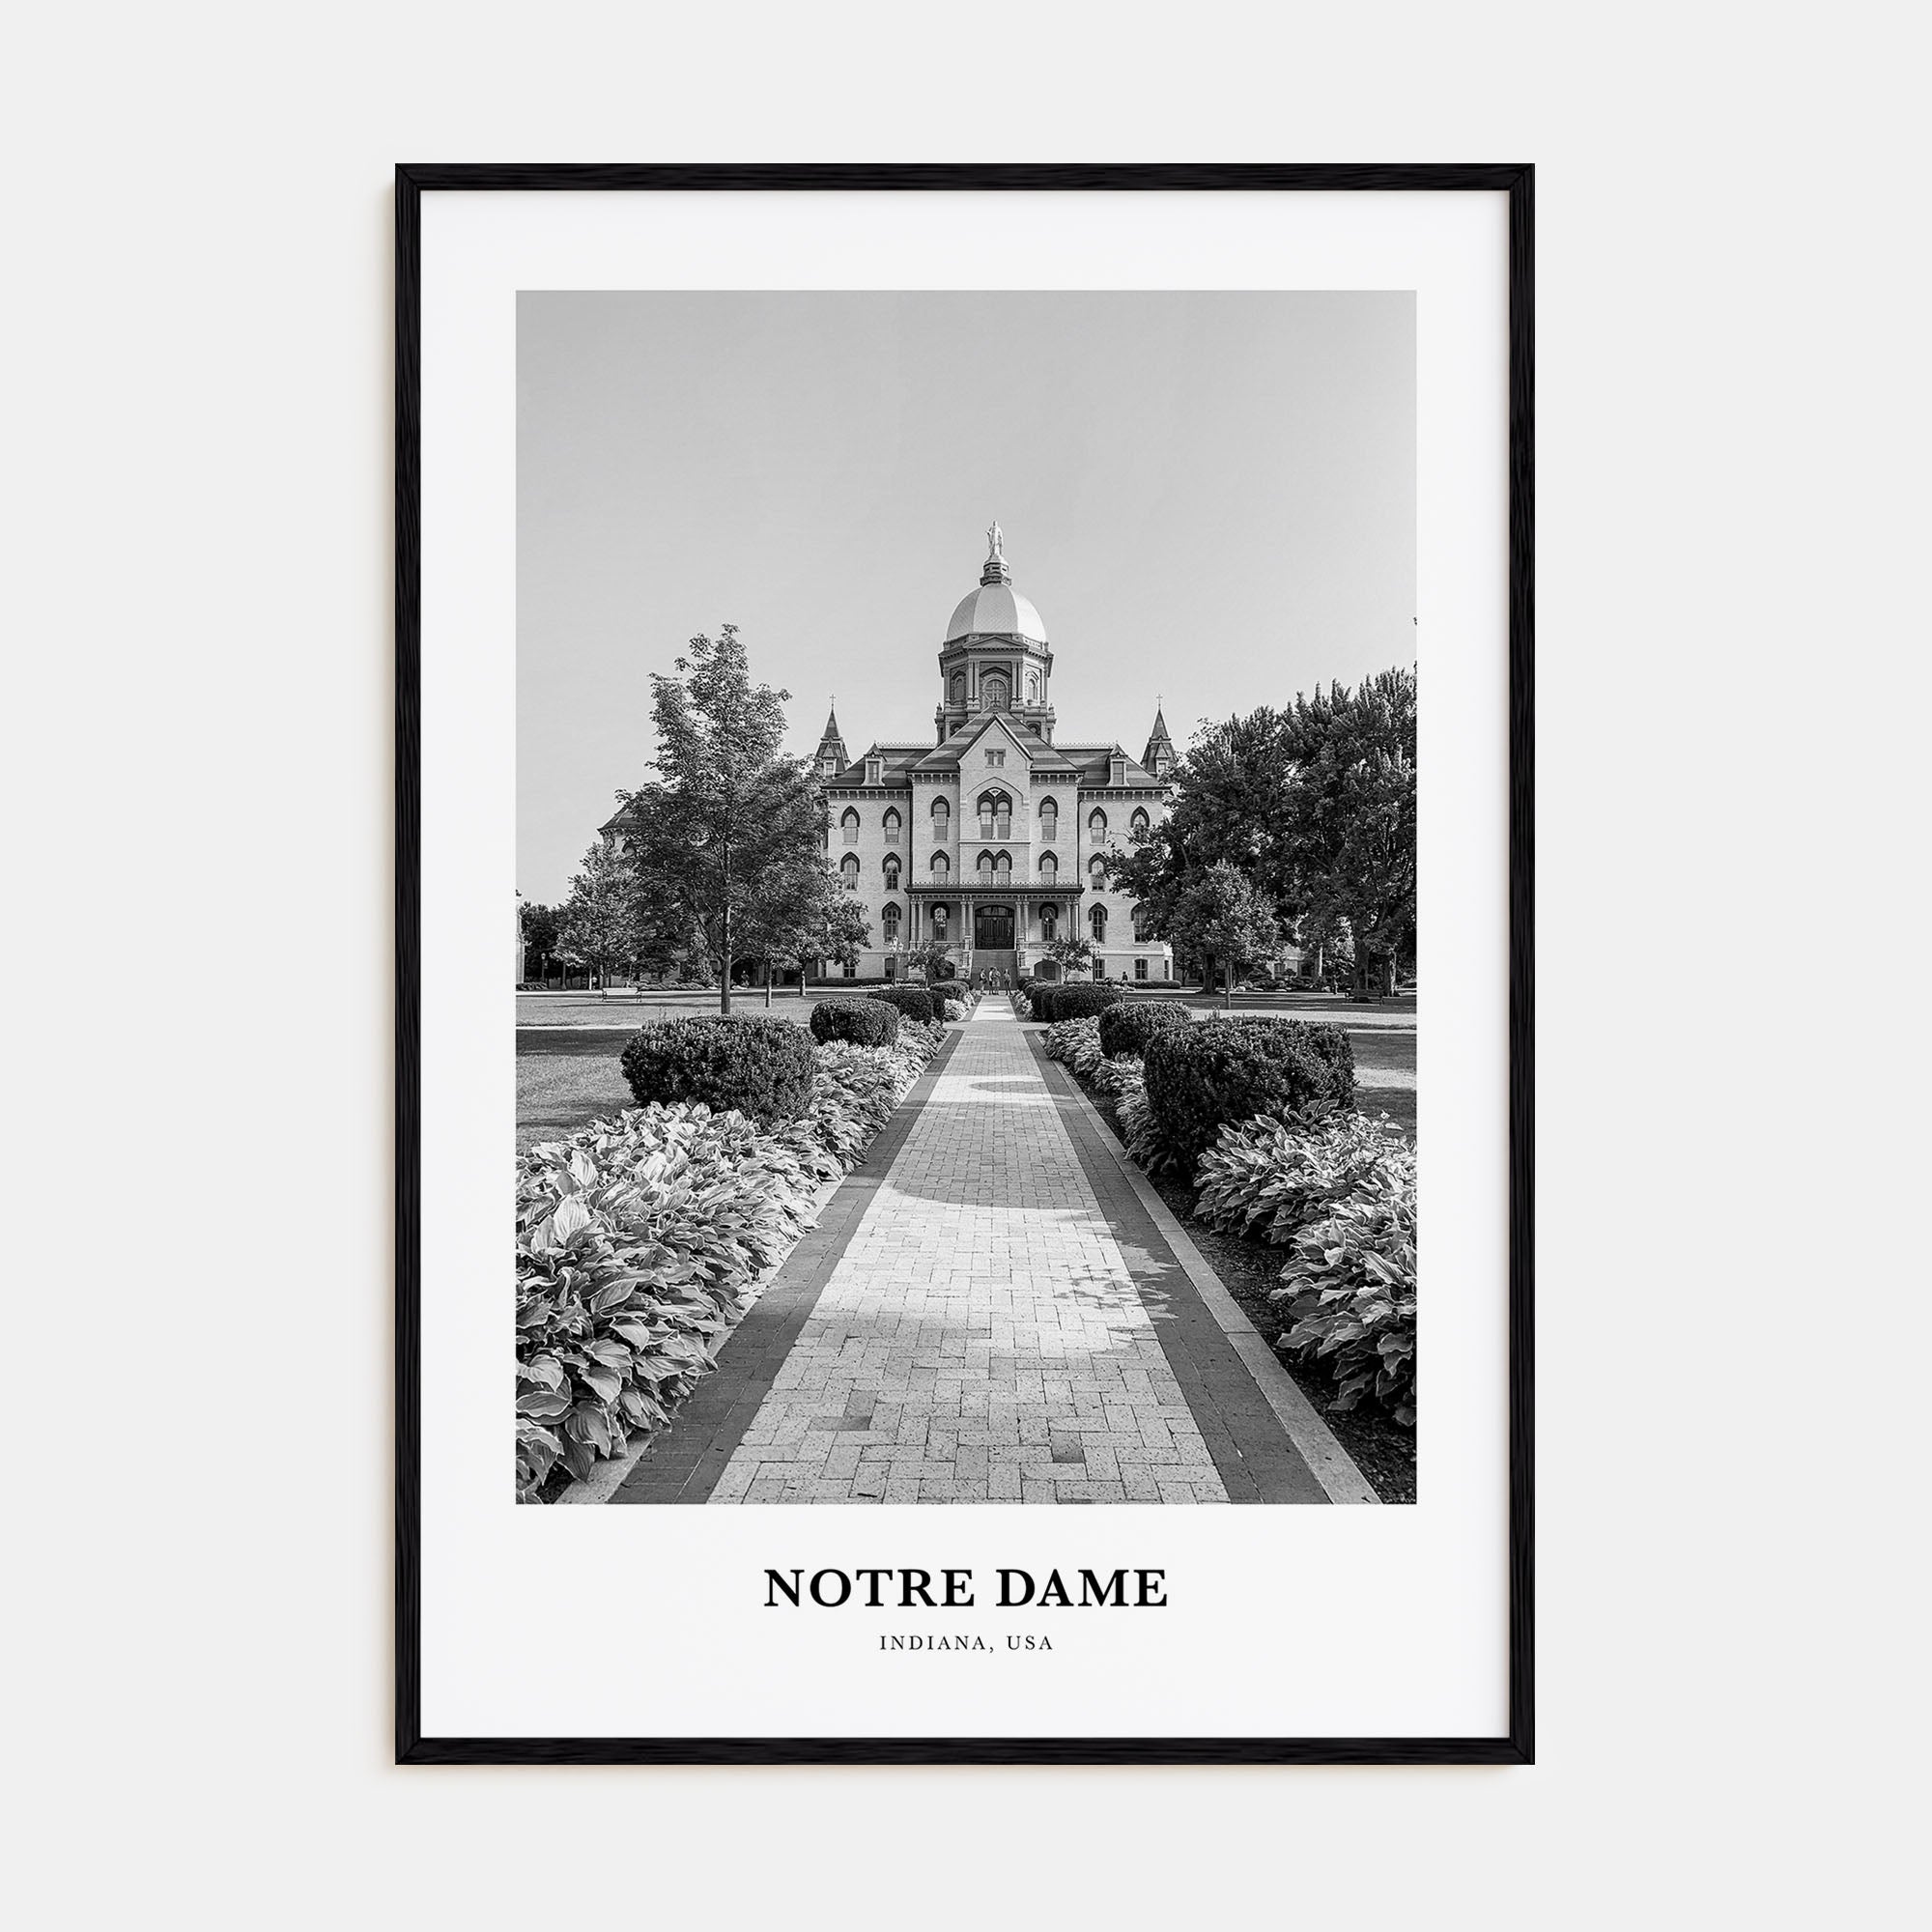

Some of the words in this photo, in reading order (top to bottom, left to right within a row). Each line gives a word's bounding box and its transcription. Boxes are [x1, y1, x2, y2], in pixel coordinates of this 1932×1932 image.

[763, 1568, 975, 1607] NOTRE
[995, 1568, 1168, 1607] DAME
[880, 1635, 994, 1654] INDIANA,
[1007, 1635, 1053, 1651] USA
